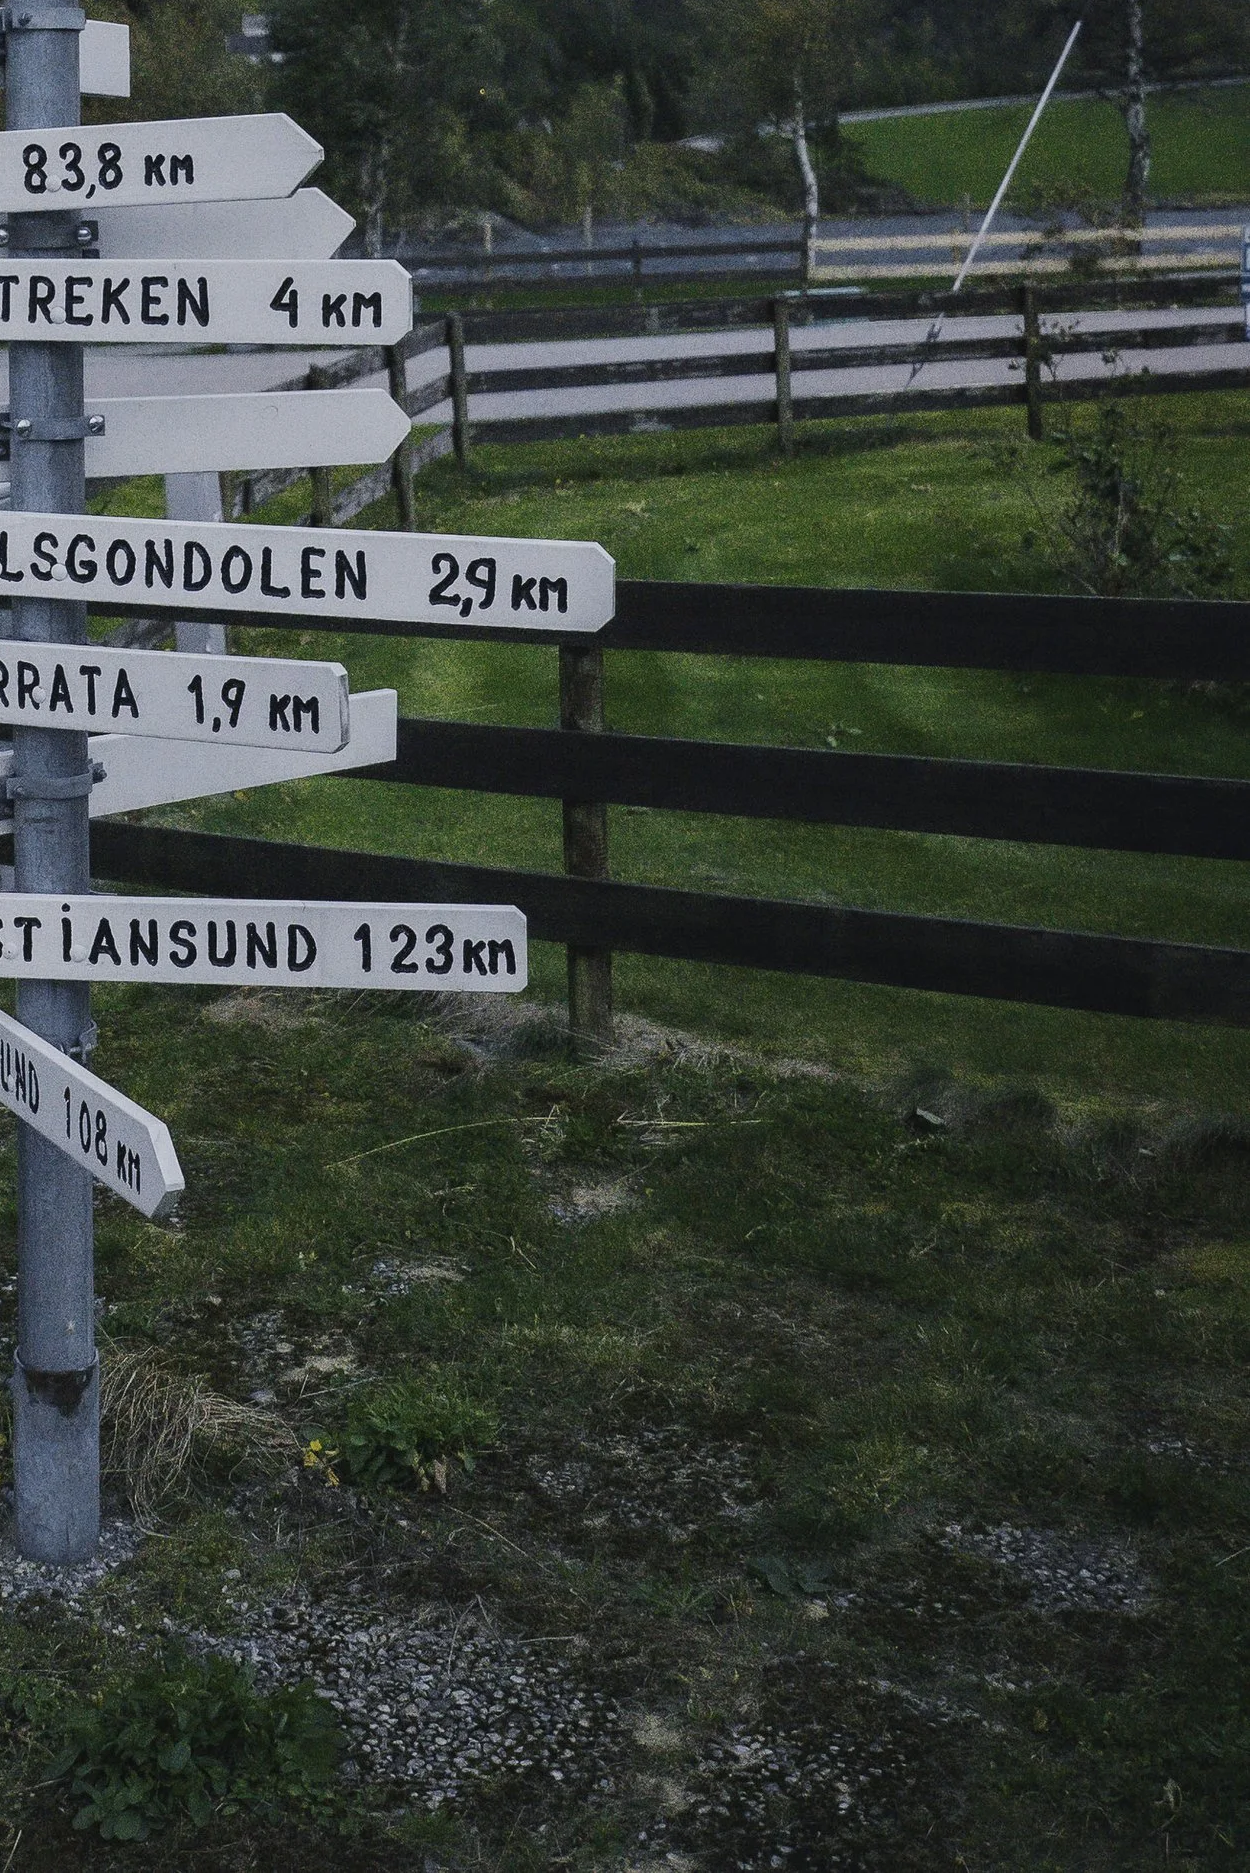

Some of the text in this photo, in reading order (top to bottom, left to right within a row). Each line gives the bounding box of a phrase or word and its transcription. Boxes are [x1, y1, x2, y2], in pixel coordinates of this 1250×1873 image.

[23, 142, 123, 199] 83,8
[269, 277, 298, 328] 4
[428, 552, 497, 618] 2,9
[187, 674, 246, 733] 1,9
[63, 1087, 108, 1166] 108
